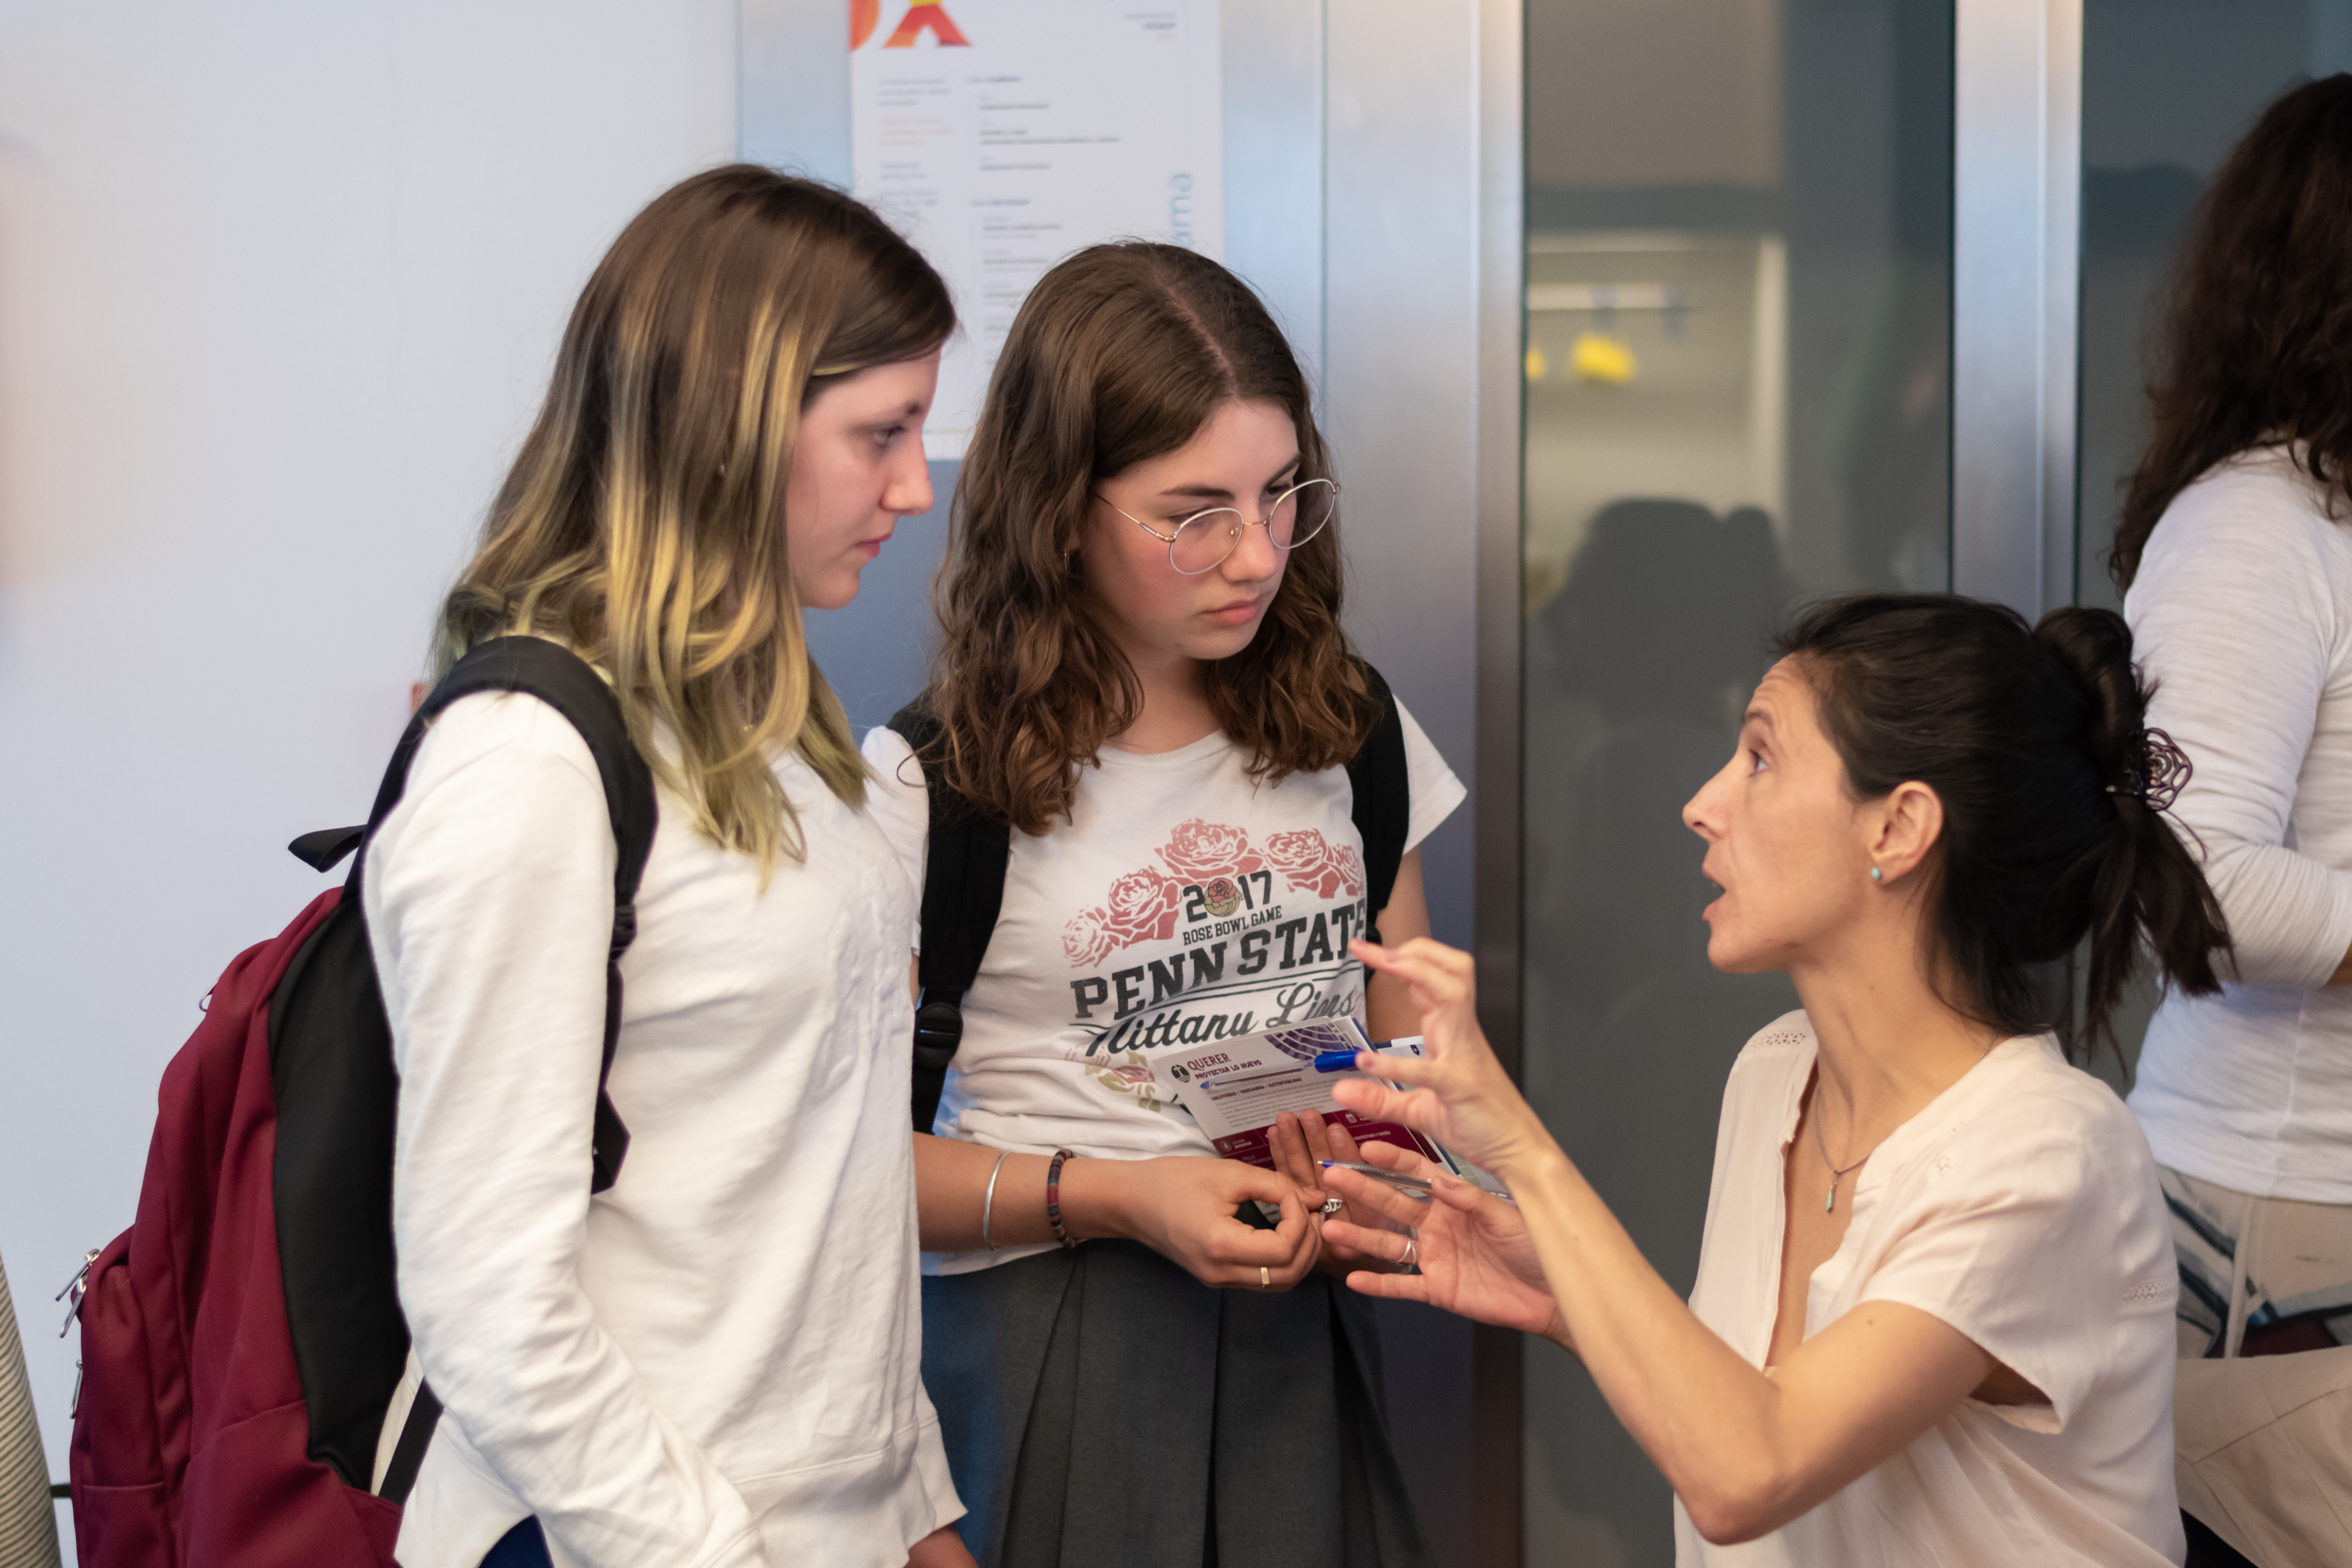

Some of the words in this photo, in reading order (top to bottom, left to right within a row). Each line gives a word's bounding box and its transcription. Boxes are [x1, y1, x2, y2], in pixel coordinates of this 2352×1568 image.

[1183, 925, 1213, 946] ROSE
[1214, 916, 1249, 937] BOWL
[1251, 905, 1282, 926] GAME
[1070, 941, 1227, 1020] PENN
[1187, 1053, 1232, 1071] QUERER
[1195, 1066, 1231, 1080] PROYECTAR
[1241, 1060, 1262, 1069] NUEVO
